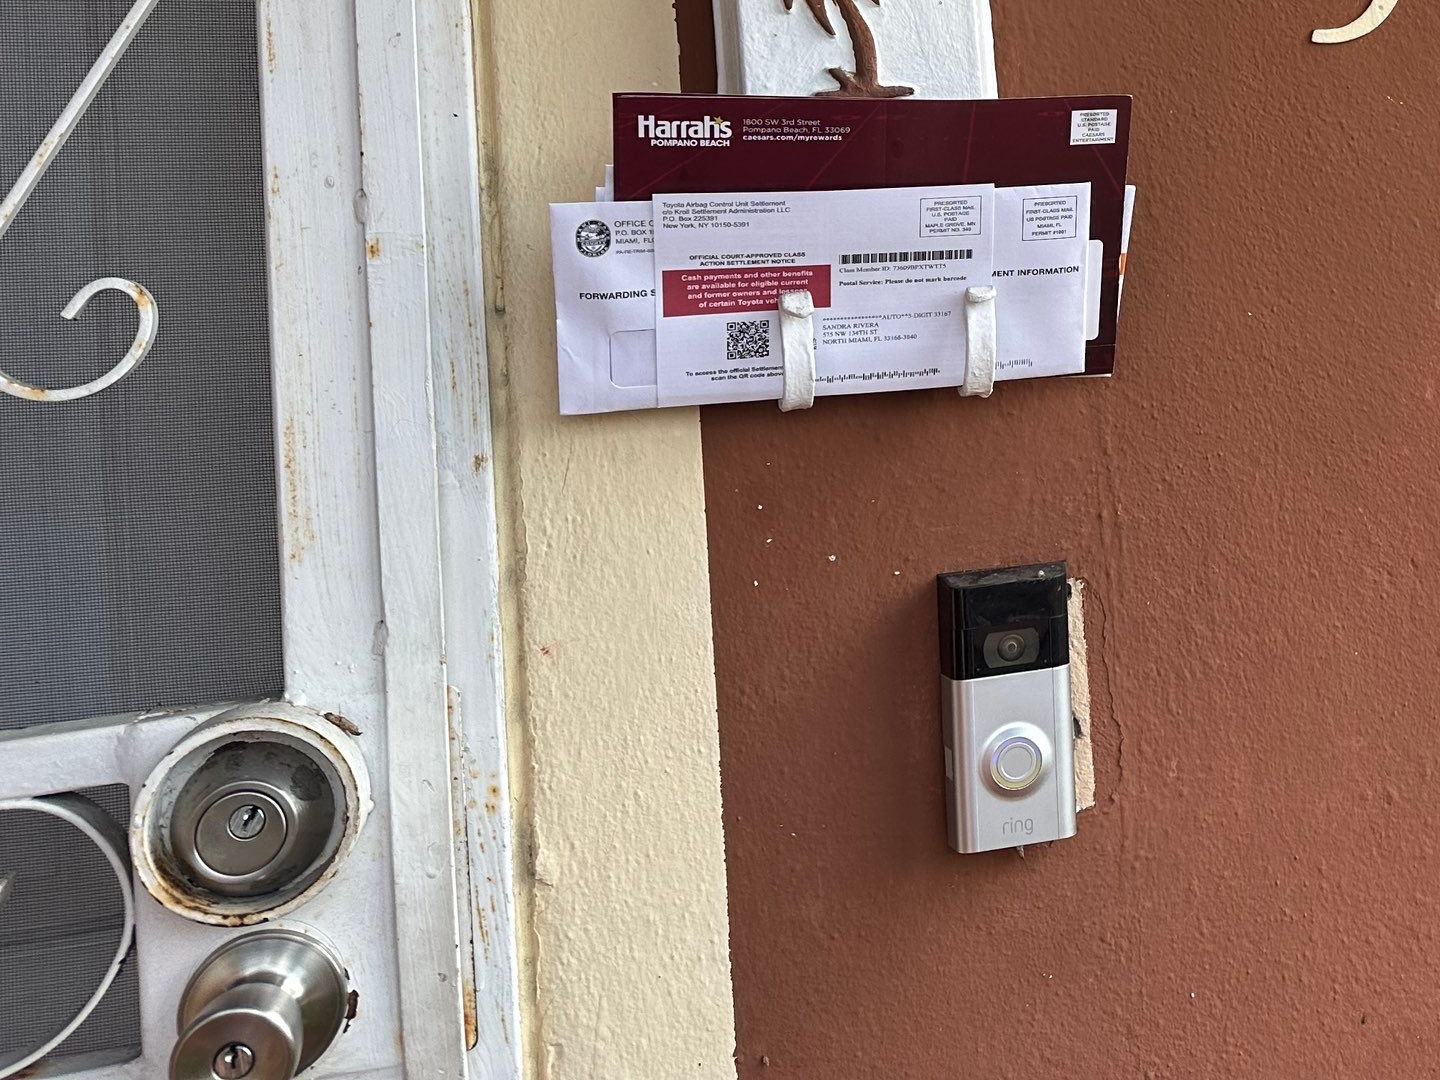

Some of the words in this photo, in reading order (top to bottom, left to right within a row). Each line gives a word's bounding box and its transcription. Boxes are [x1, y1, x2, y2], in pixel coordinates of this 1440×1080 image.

[743, 126, 781, 135] Pompano
[784, 126, 809, 134] Beach,
[742, 134, 842, 142] caesars.com/myrewards
[650, 139, 698, 147] POMPANO
[700, 139, 730, 147] BEACH
[1017, 266, 1080, 276] INFORMATION
[704, 273, 742, 281] payments
[701, 282, 736, 290] available
[751, 280, 778, 289] eligible
[579, 289, 648, 300] FORWARDING
[737, 299, 763, 307] Toyota
[1002, 818, 1034, 835] ring
